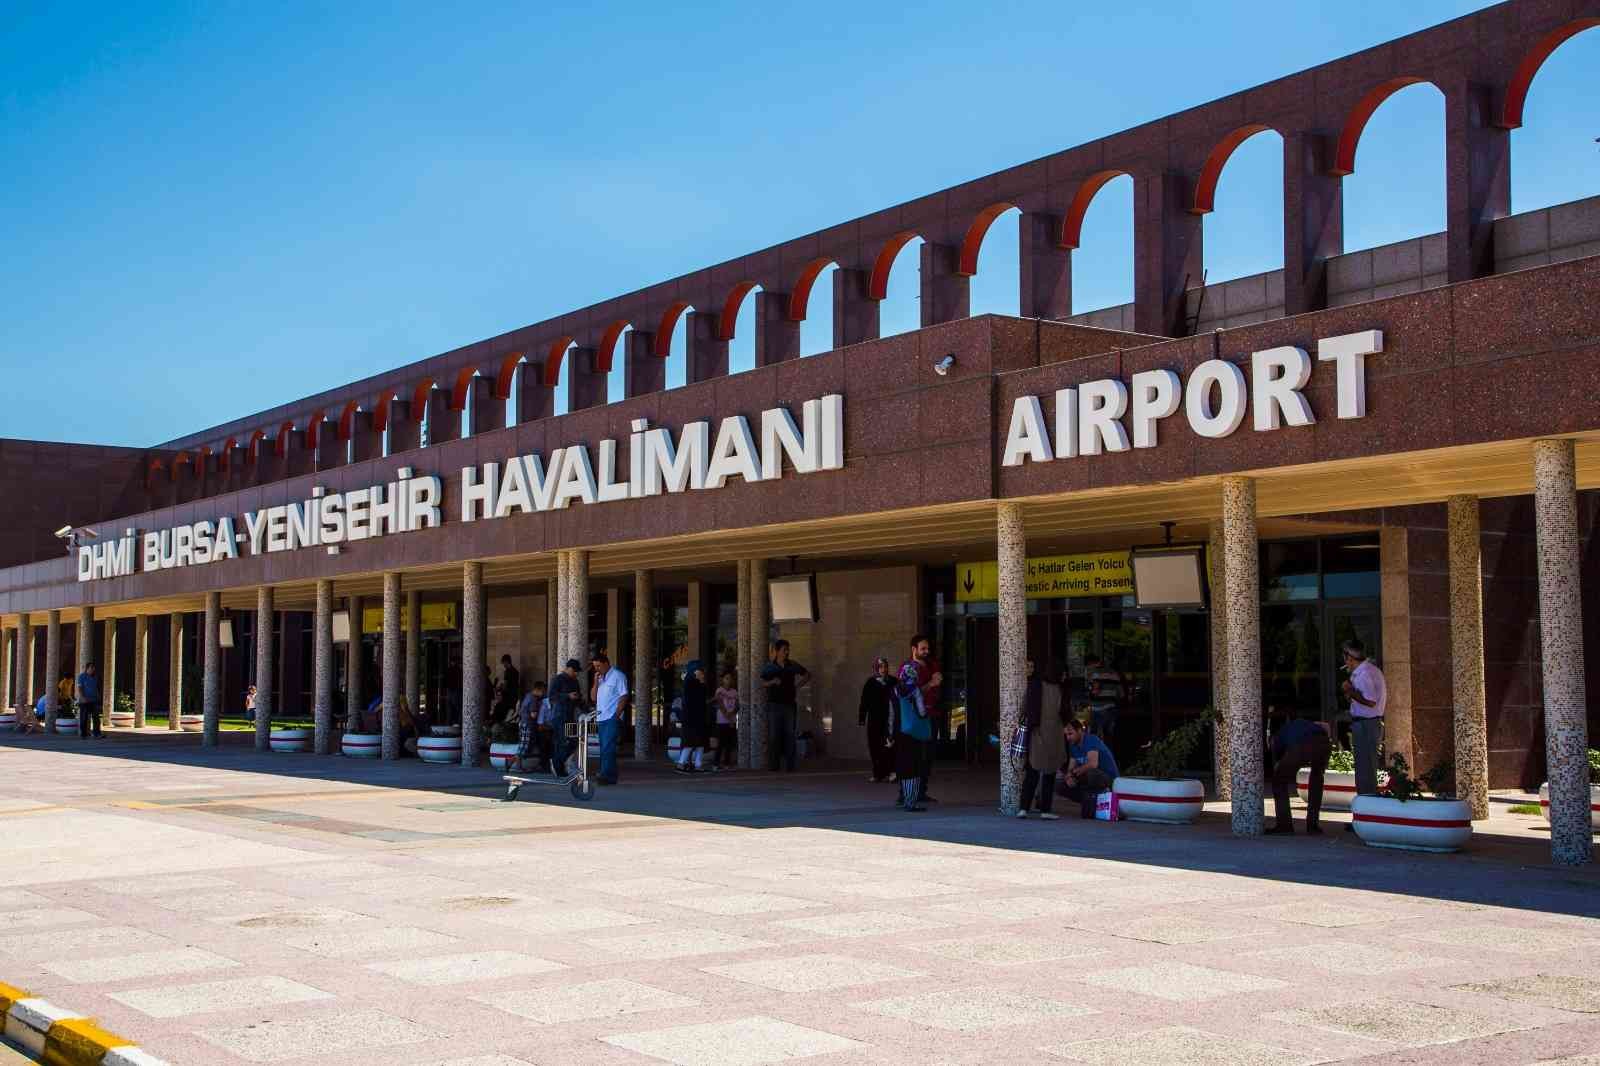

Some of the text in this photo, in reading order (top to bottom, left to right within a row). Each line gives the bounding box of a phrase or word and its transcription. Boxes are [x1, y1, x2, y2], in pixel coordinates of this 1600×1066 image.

[1002, 329, 1383, 467] AIRPORT
[78, 394, 844, 582] DHMİ BURSA-YENİŞEHİR HAVALİMANI
[1039, 561, 1066, 574] Hatlar
[1068, 559, 1096, 573] Gelen
[1098, 558, 1125, 570] Yolcu
[1051, 578, 1090, 592] Arriving
